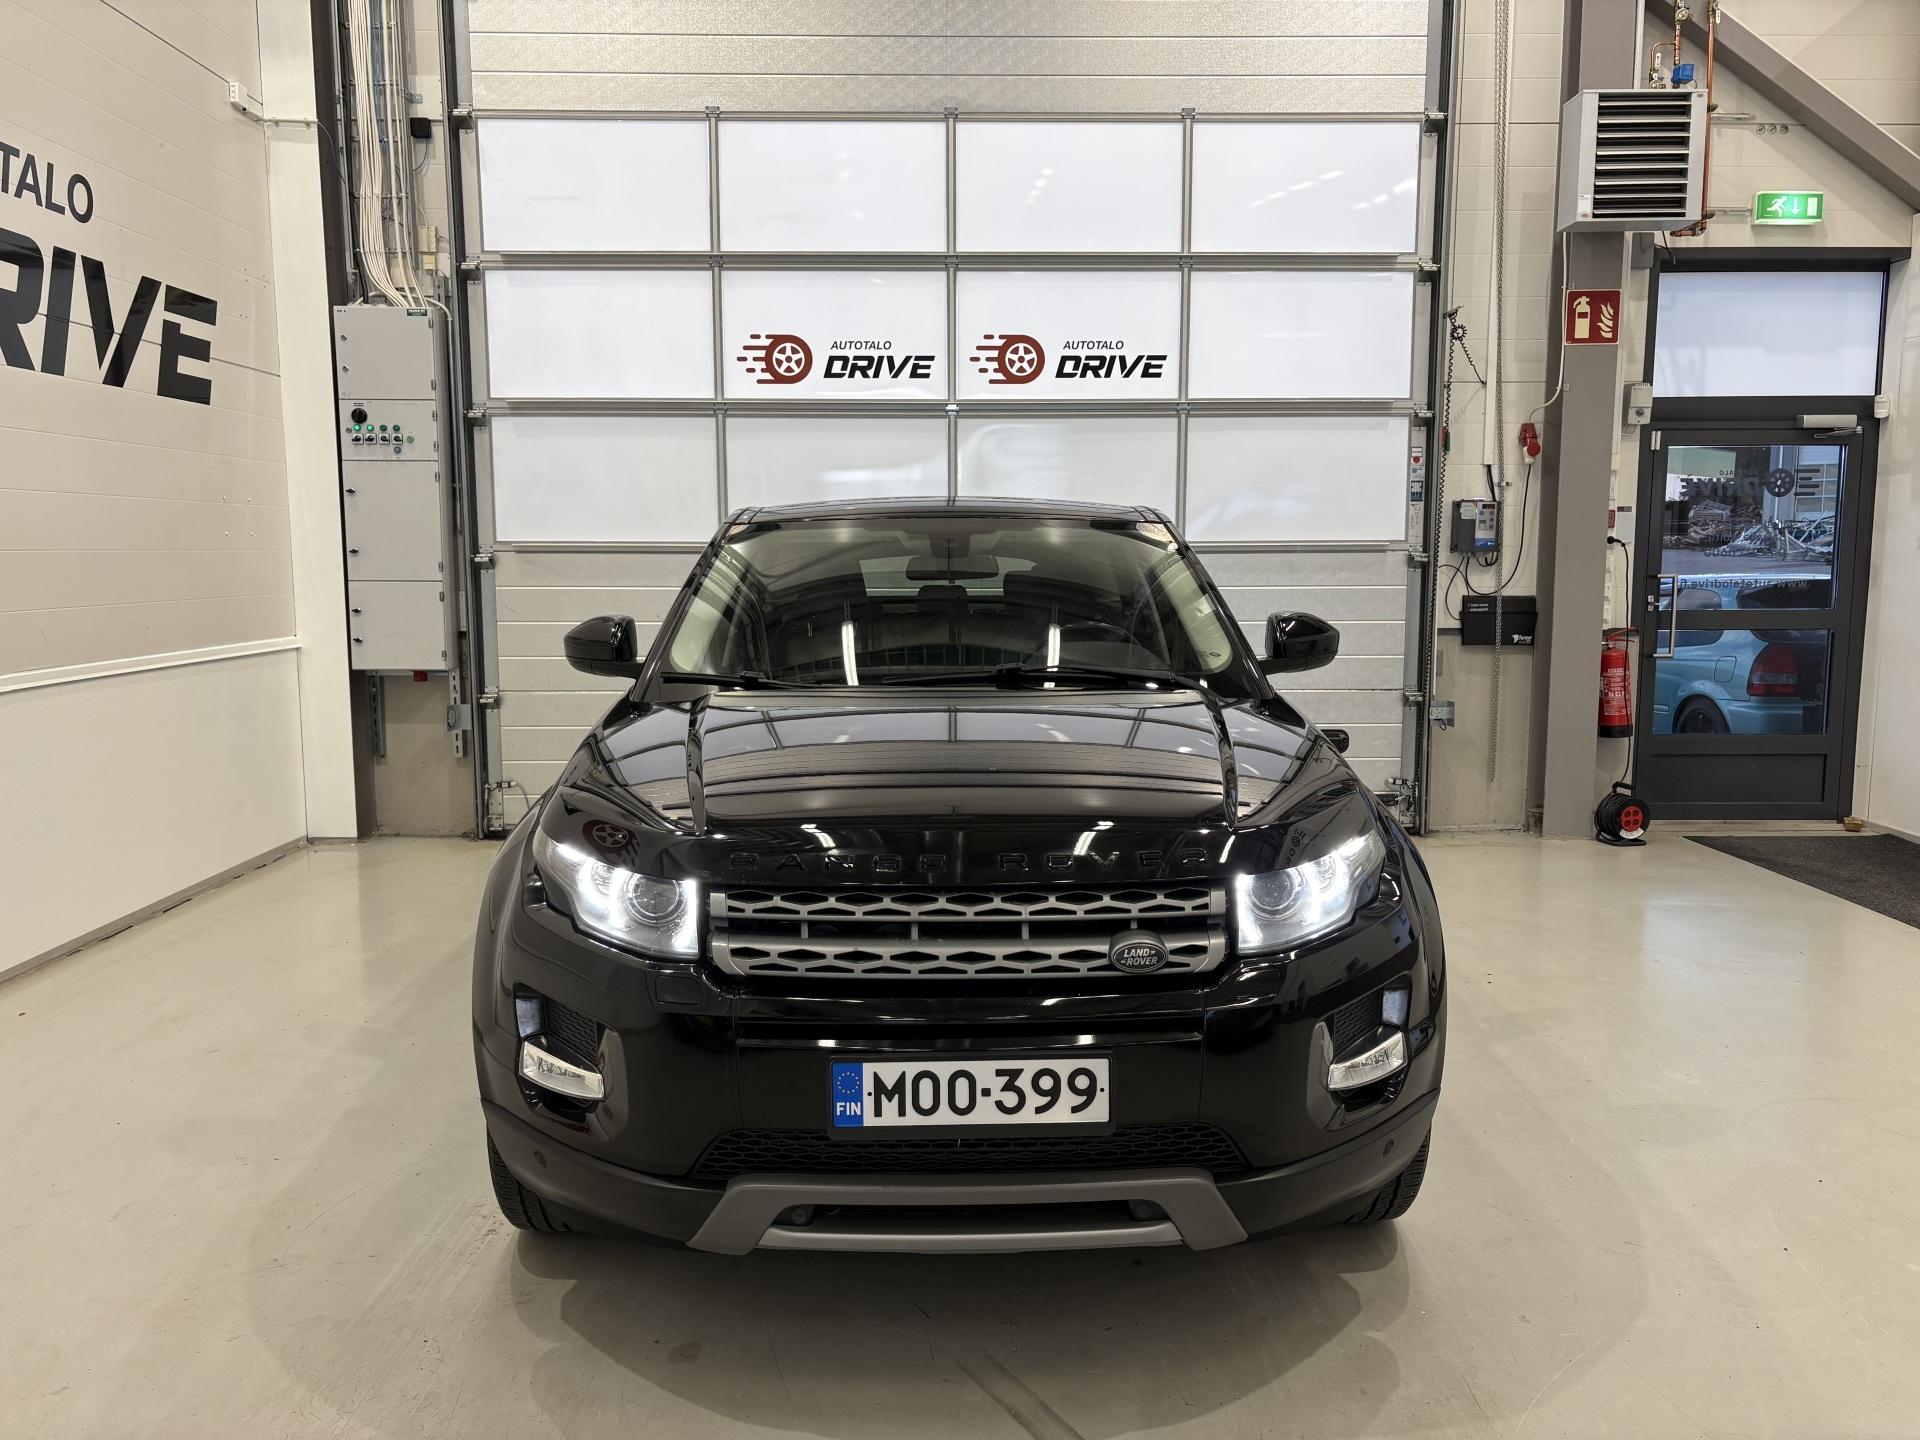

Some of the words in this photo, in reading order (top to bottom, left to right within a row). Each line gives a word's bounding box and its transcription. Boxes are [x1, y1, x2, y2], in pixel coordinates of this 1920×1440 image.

[830, 340, 892, 350] AUTOTALO
[1062, 340, 1125, 350] AUTOTALO
[823, 355, 936, 379] DRIVE
[1055, 354, 1168, 379] DRIVE
[730, 851, 946, 873] RANGE
[999, 847, 1208, 871] ROVER
[1123, 948, 1150, 958] LAND
[1126, 956, 1158, 966] ROVER
[836, 1102, 861, 1116] FIN
[873, 1067, 1098, 1118] MOO-399
